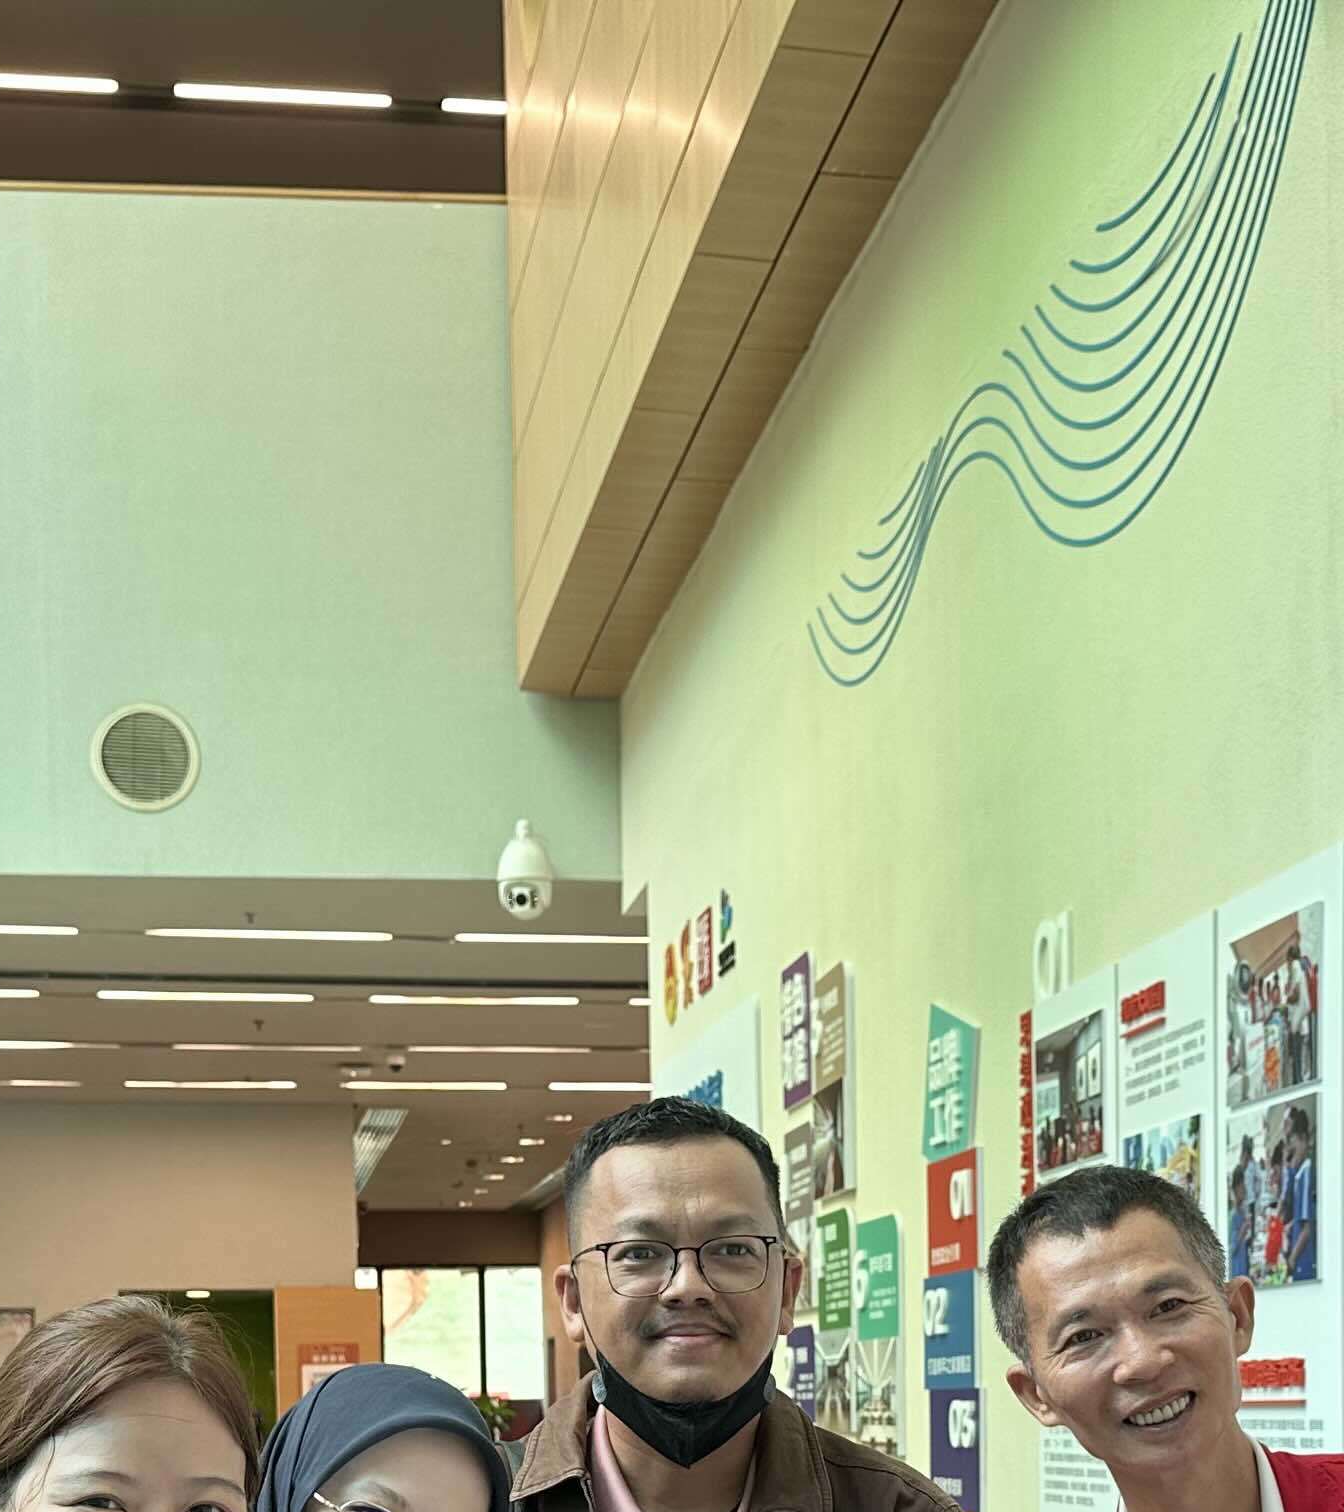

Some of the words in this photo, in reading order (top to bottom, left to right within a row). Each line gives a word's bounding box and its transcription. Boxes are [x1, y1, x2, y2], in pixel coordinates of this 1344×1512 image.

[1033, 909, 1072, 1000] 01
[929, 1088, 963, 1147] 工作
[949, 1168, 973, 1221] 01
[924, 1287, 949, 1336] 02
[948, 1398, 975, 1449] 03
